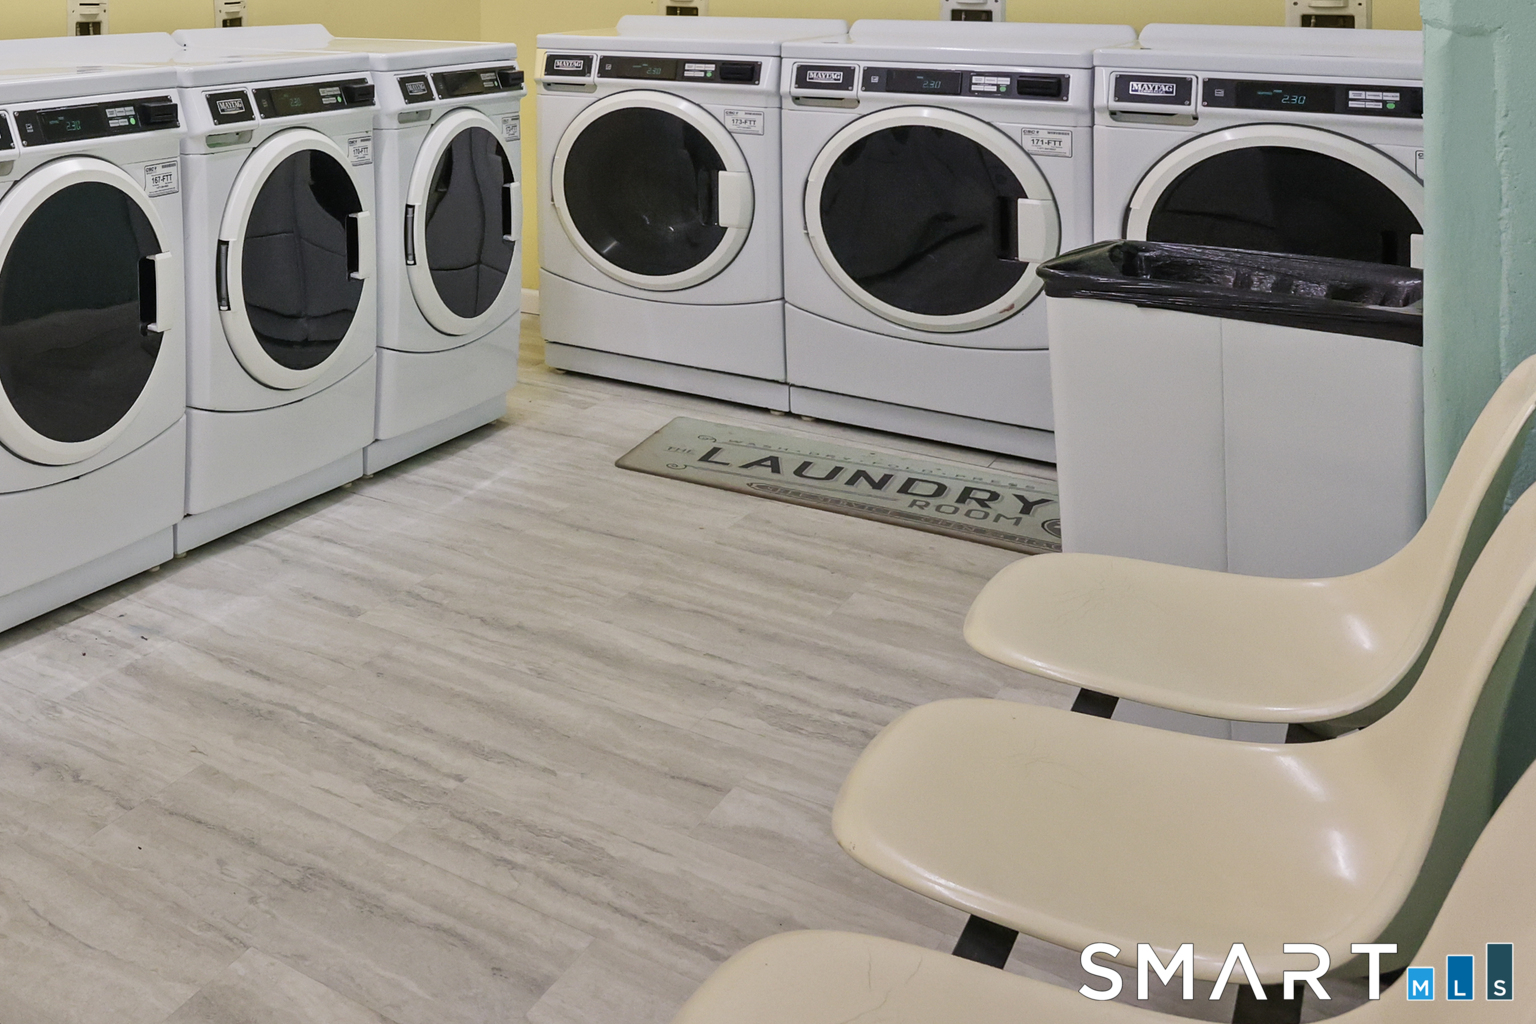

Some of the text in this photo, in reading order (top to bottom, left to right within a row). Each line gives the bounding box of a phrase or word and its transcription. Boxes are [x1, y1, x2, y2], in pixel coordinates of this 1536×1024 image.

[555, 60, 582, 68] MAYTAG
[809, 72, 841, 80] MAYTAG
[1132, 83, 1173, 92] MAYTAG
[1281, 94, 1306, 105] 2.30
[218, 100, 242, 110] MAYTAG
[1031, 138, 1062, 146] 171-FTT
[697, 446, 1055, 516] LAUNDRY
[907, 499, 1023, 527] ROOM
